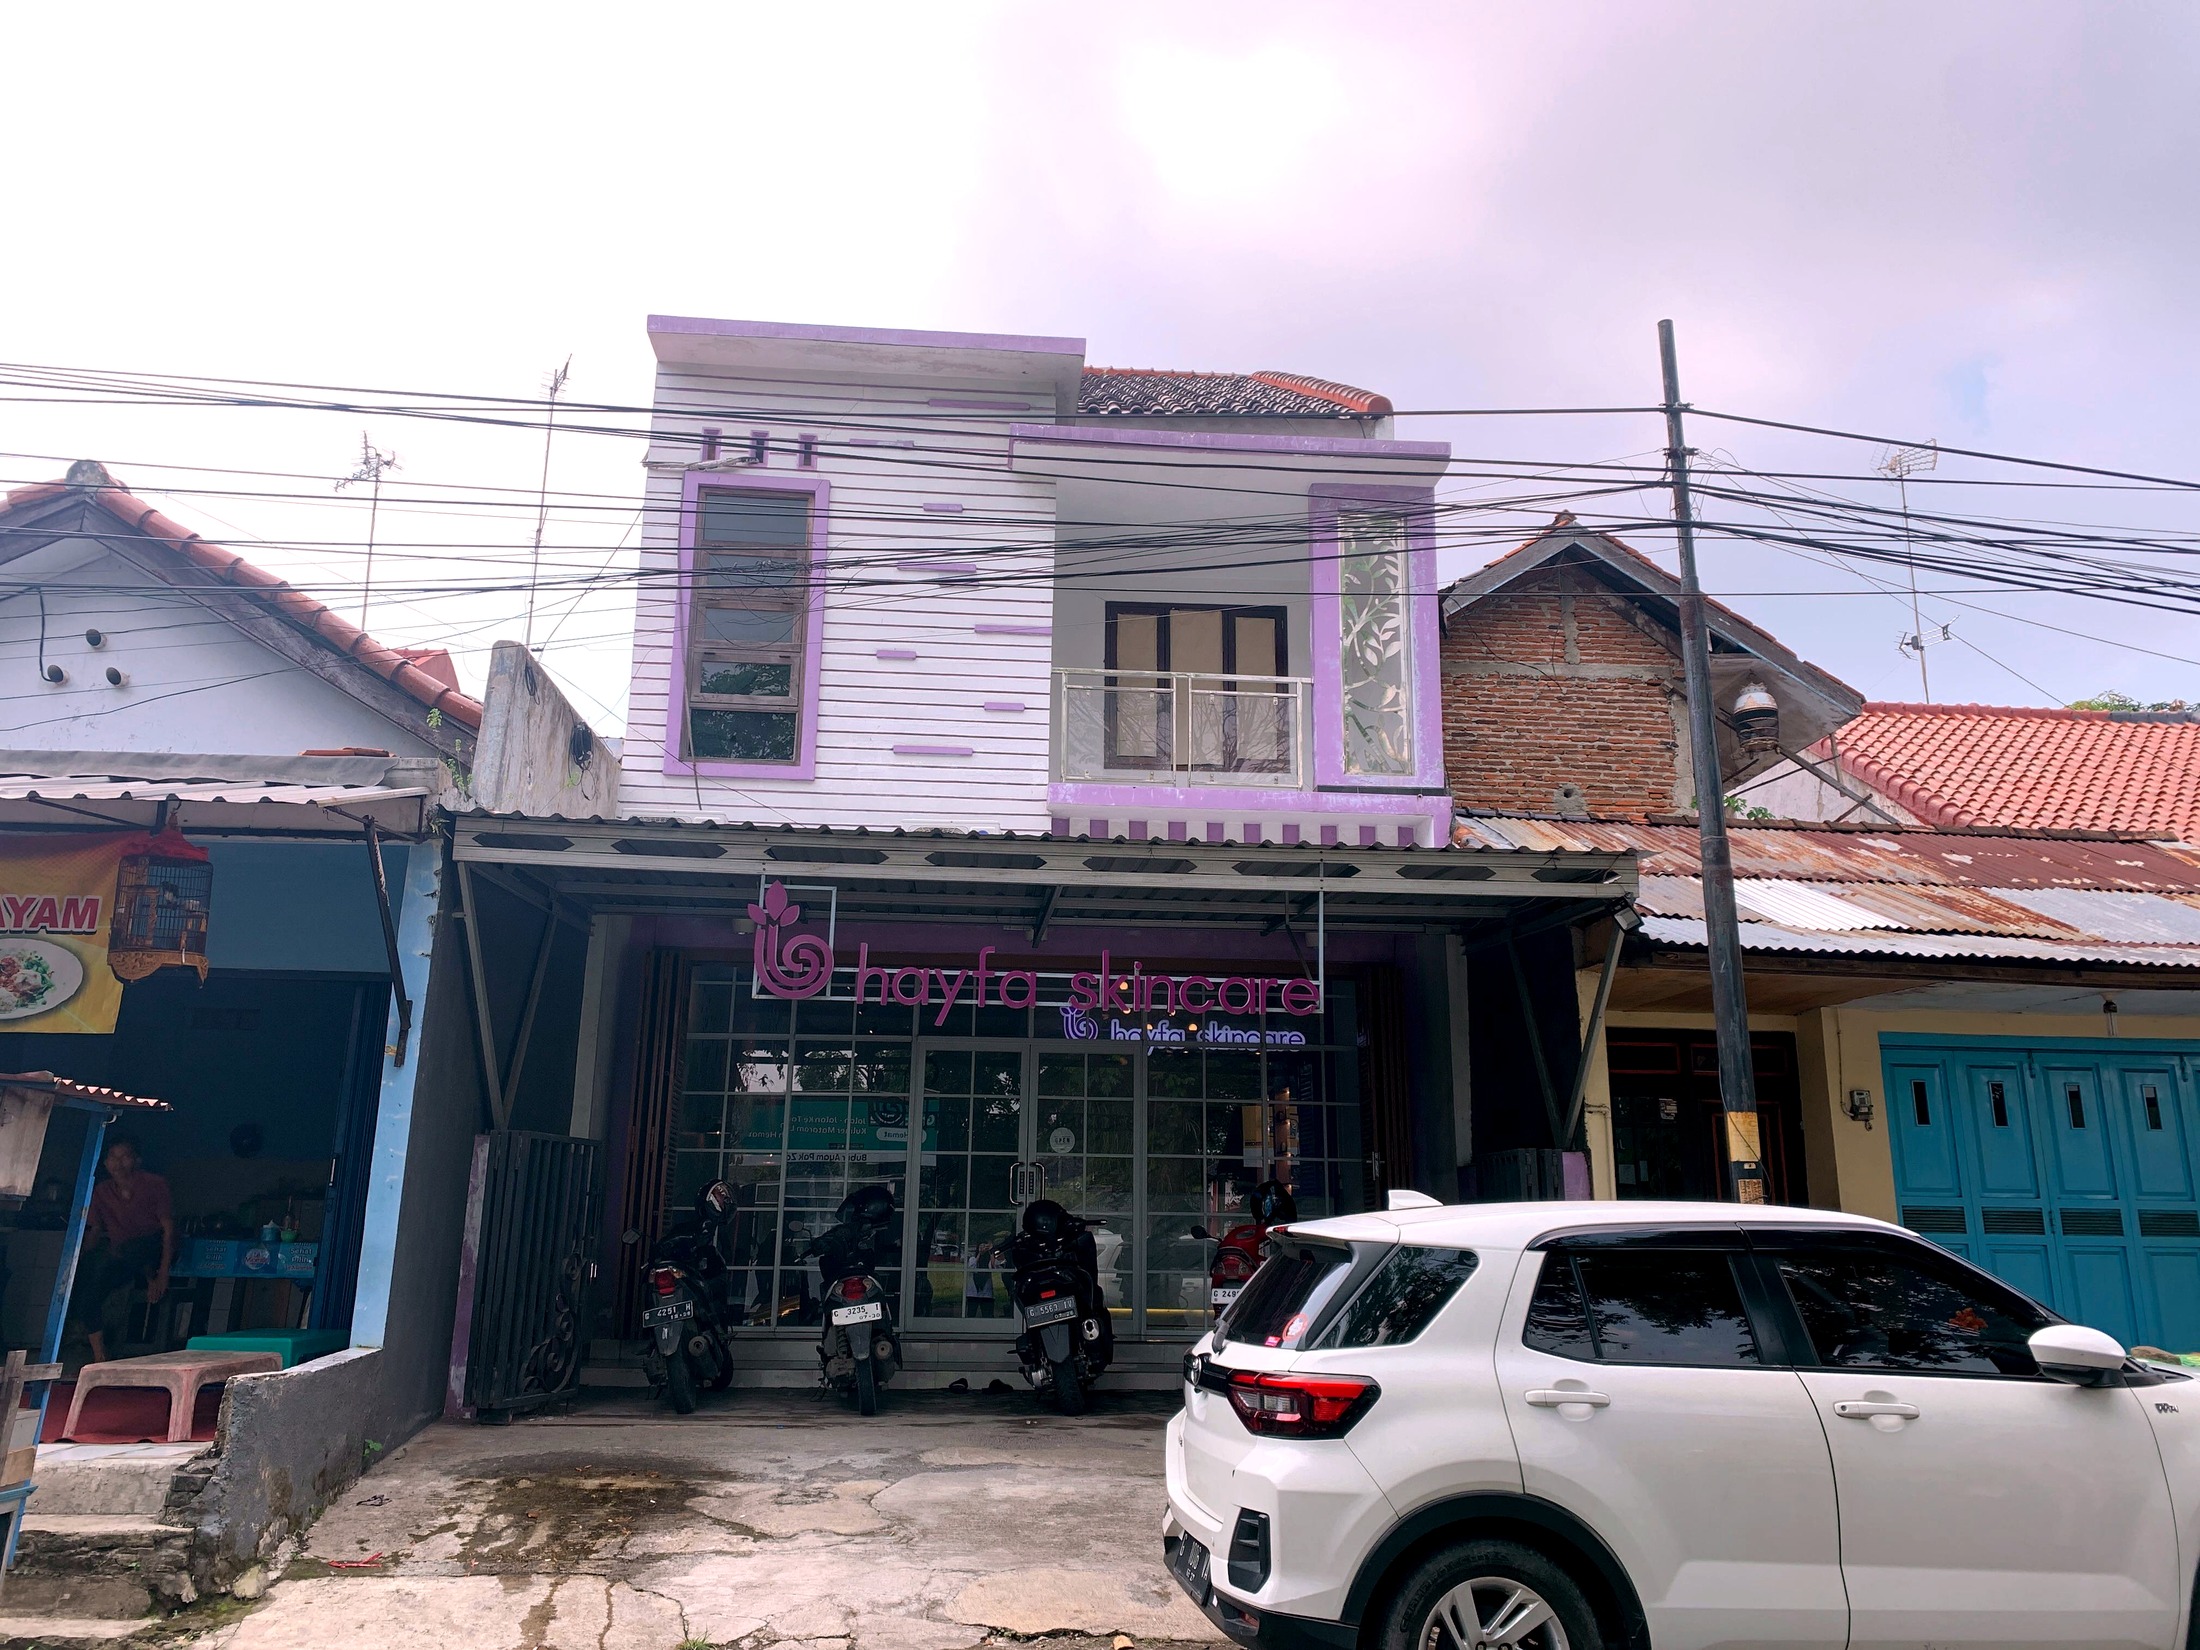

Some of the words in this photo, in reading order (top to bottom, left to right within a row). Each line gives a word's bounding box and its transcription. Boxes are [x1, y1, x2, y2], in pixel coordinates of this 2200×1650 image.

[0, 896, 100, 929] YAM
[856, 942, 1036, 1027] hayfa
[1067, 949, 1320, 1017] skincare
[1110, 1019, 1185, 1055] hayfa
[1196, 1020, 1305, 1051] skincare
[1222, 1290, 1240, 1298] 249
[657, 1306, 677, 1317] 4251
[847, 1305, 866, 1315] 3235
